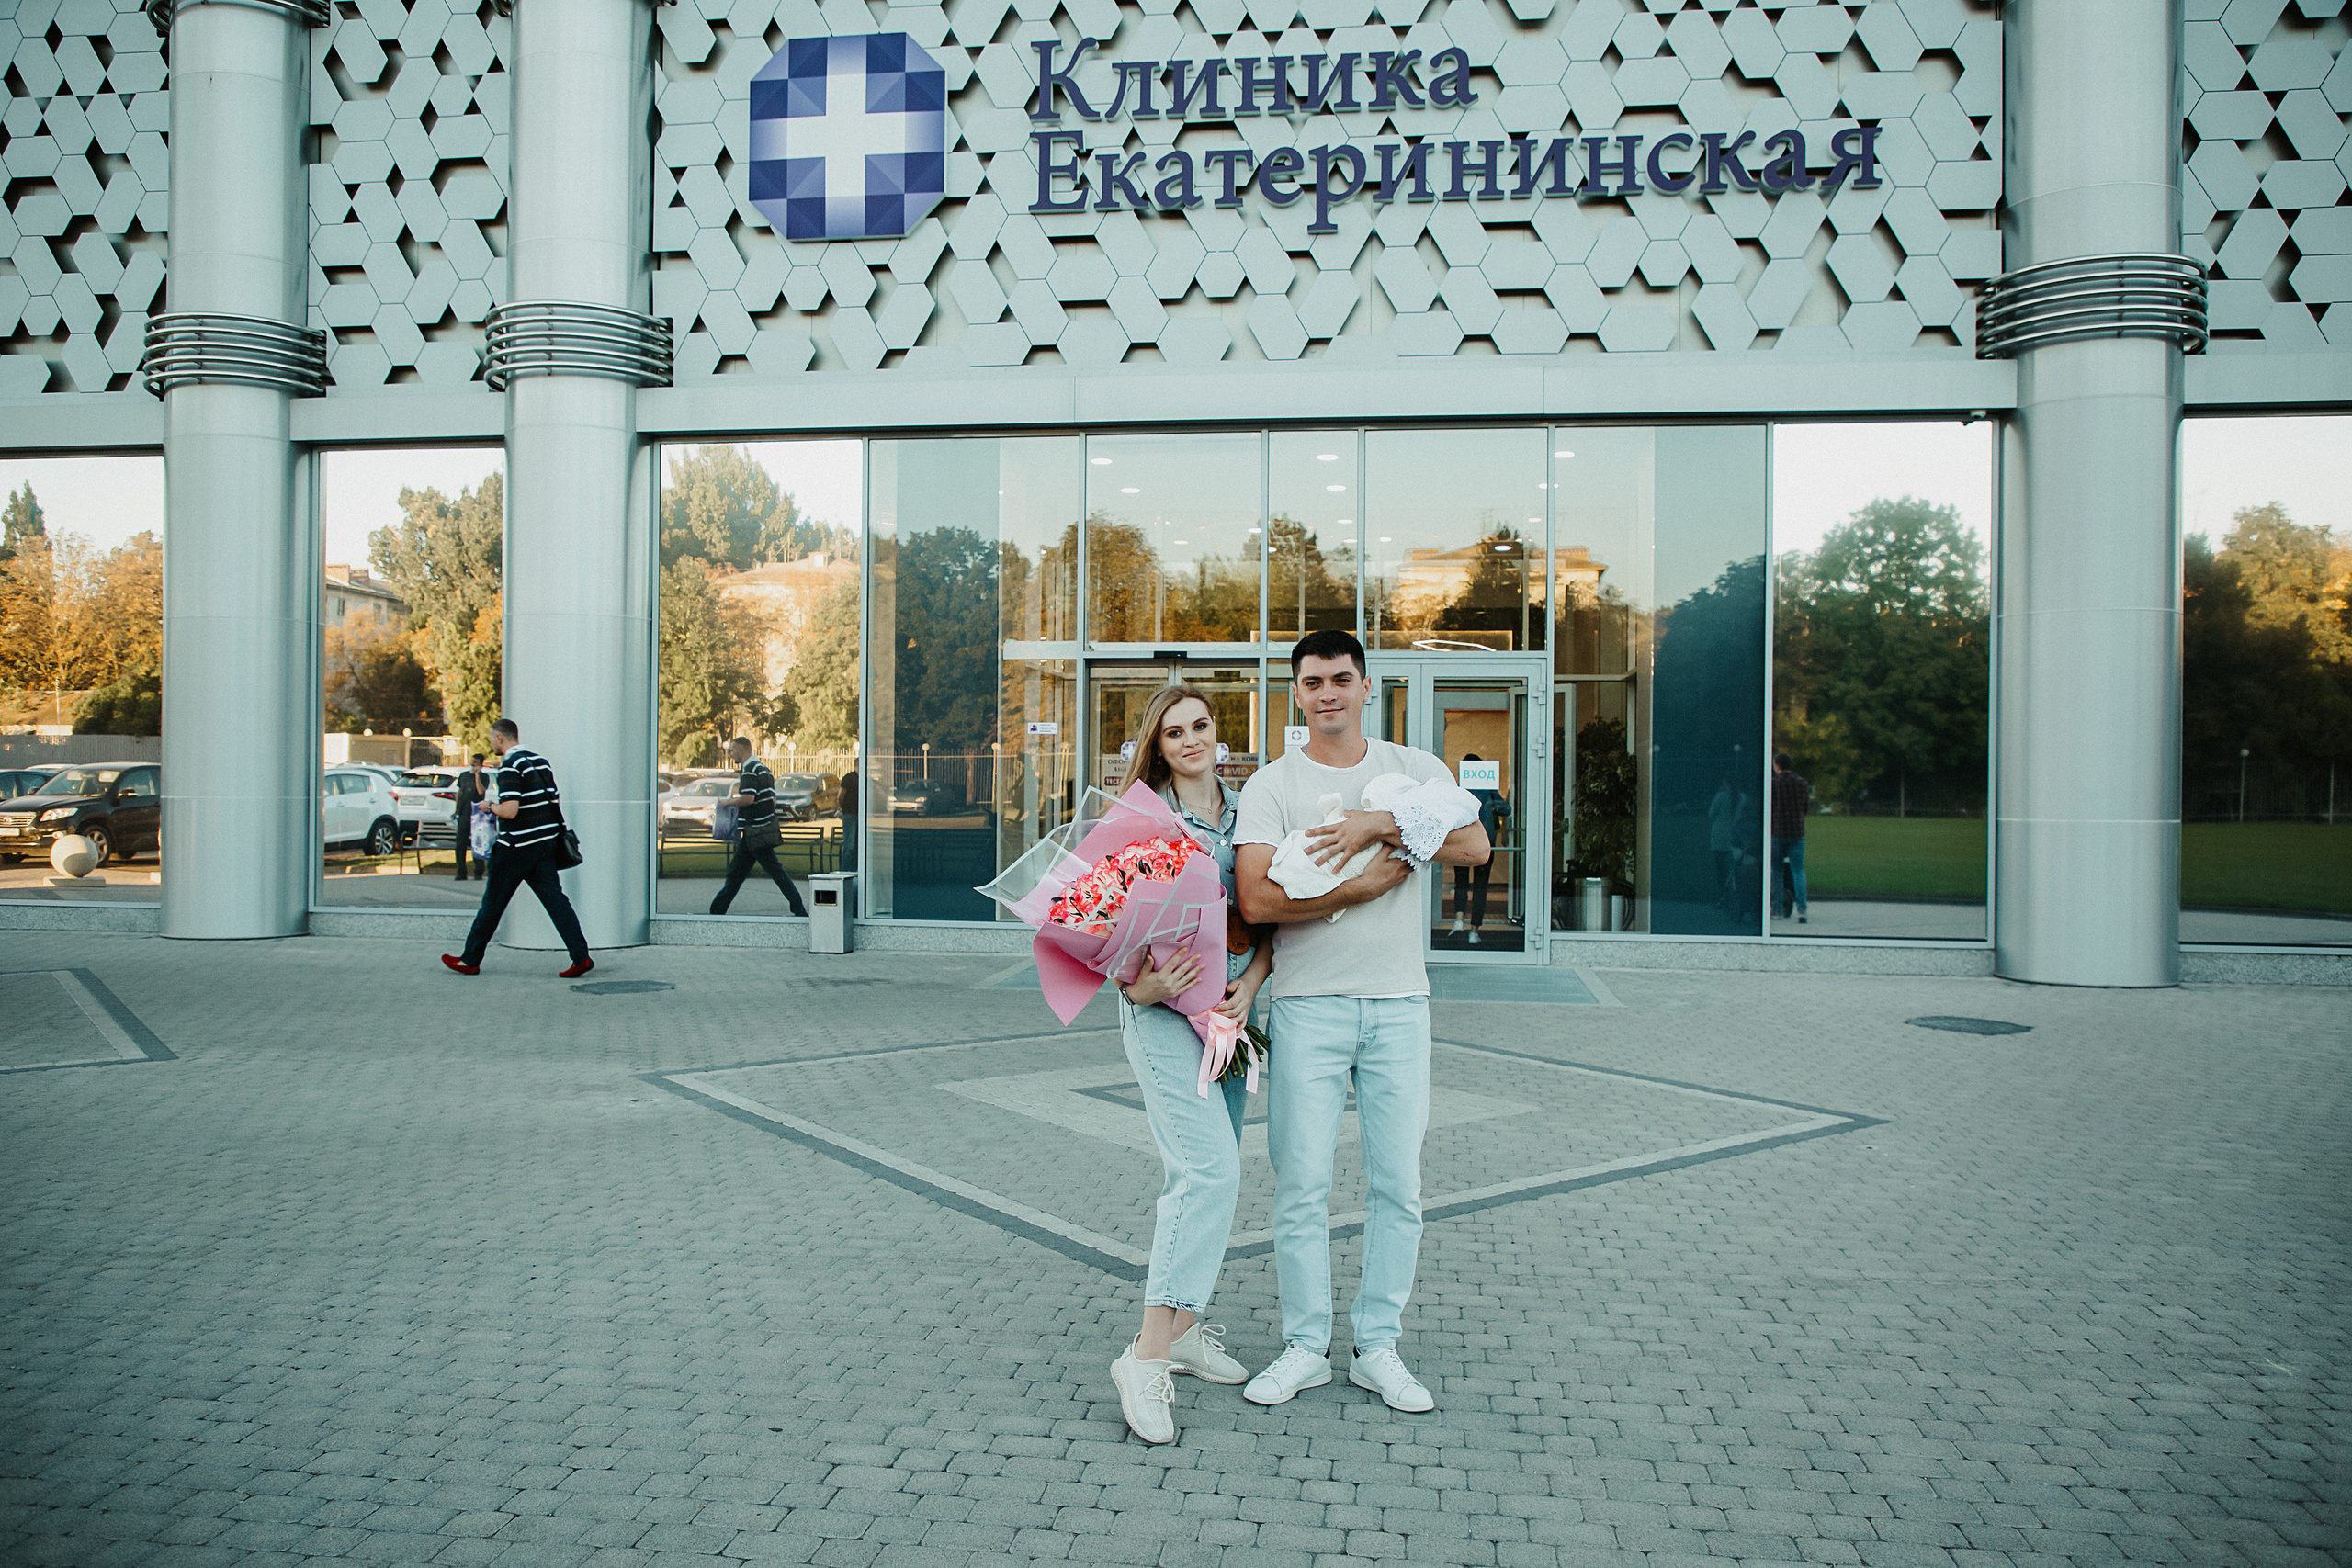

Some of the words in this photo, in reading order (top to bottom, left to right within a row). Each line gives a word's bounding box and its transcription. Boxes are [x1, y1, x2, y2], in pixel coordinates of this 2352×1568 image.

[1029, 36, 1479, 122] Клиника
[1028, 126, 1883, 234] Екатерининская
[1463, 769, 1496, 781] ВХОД
